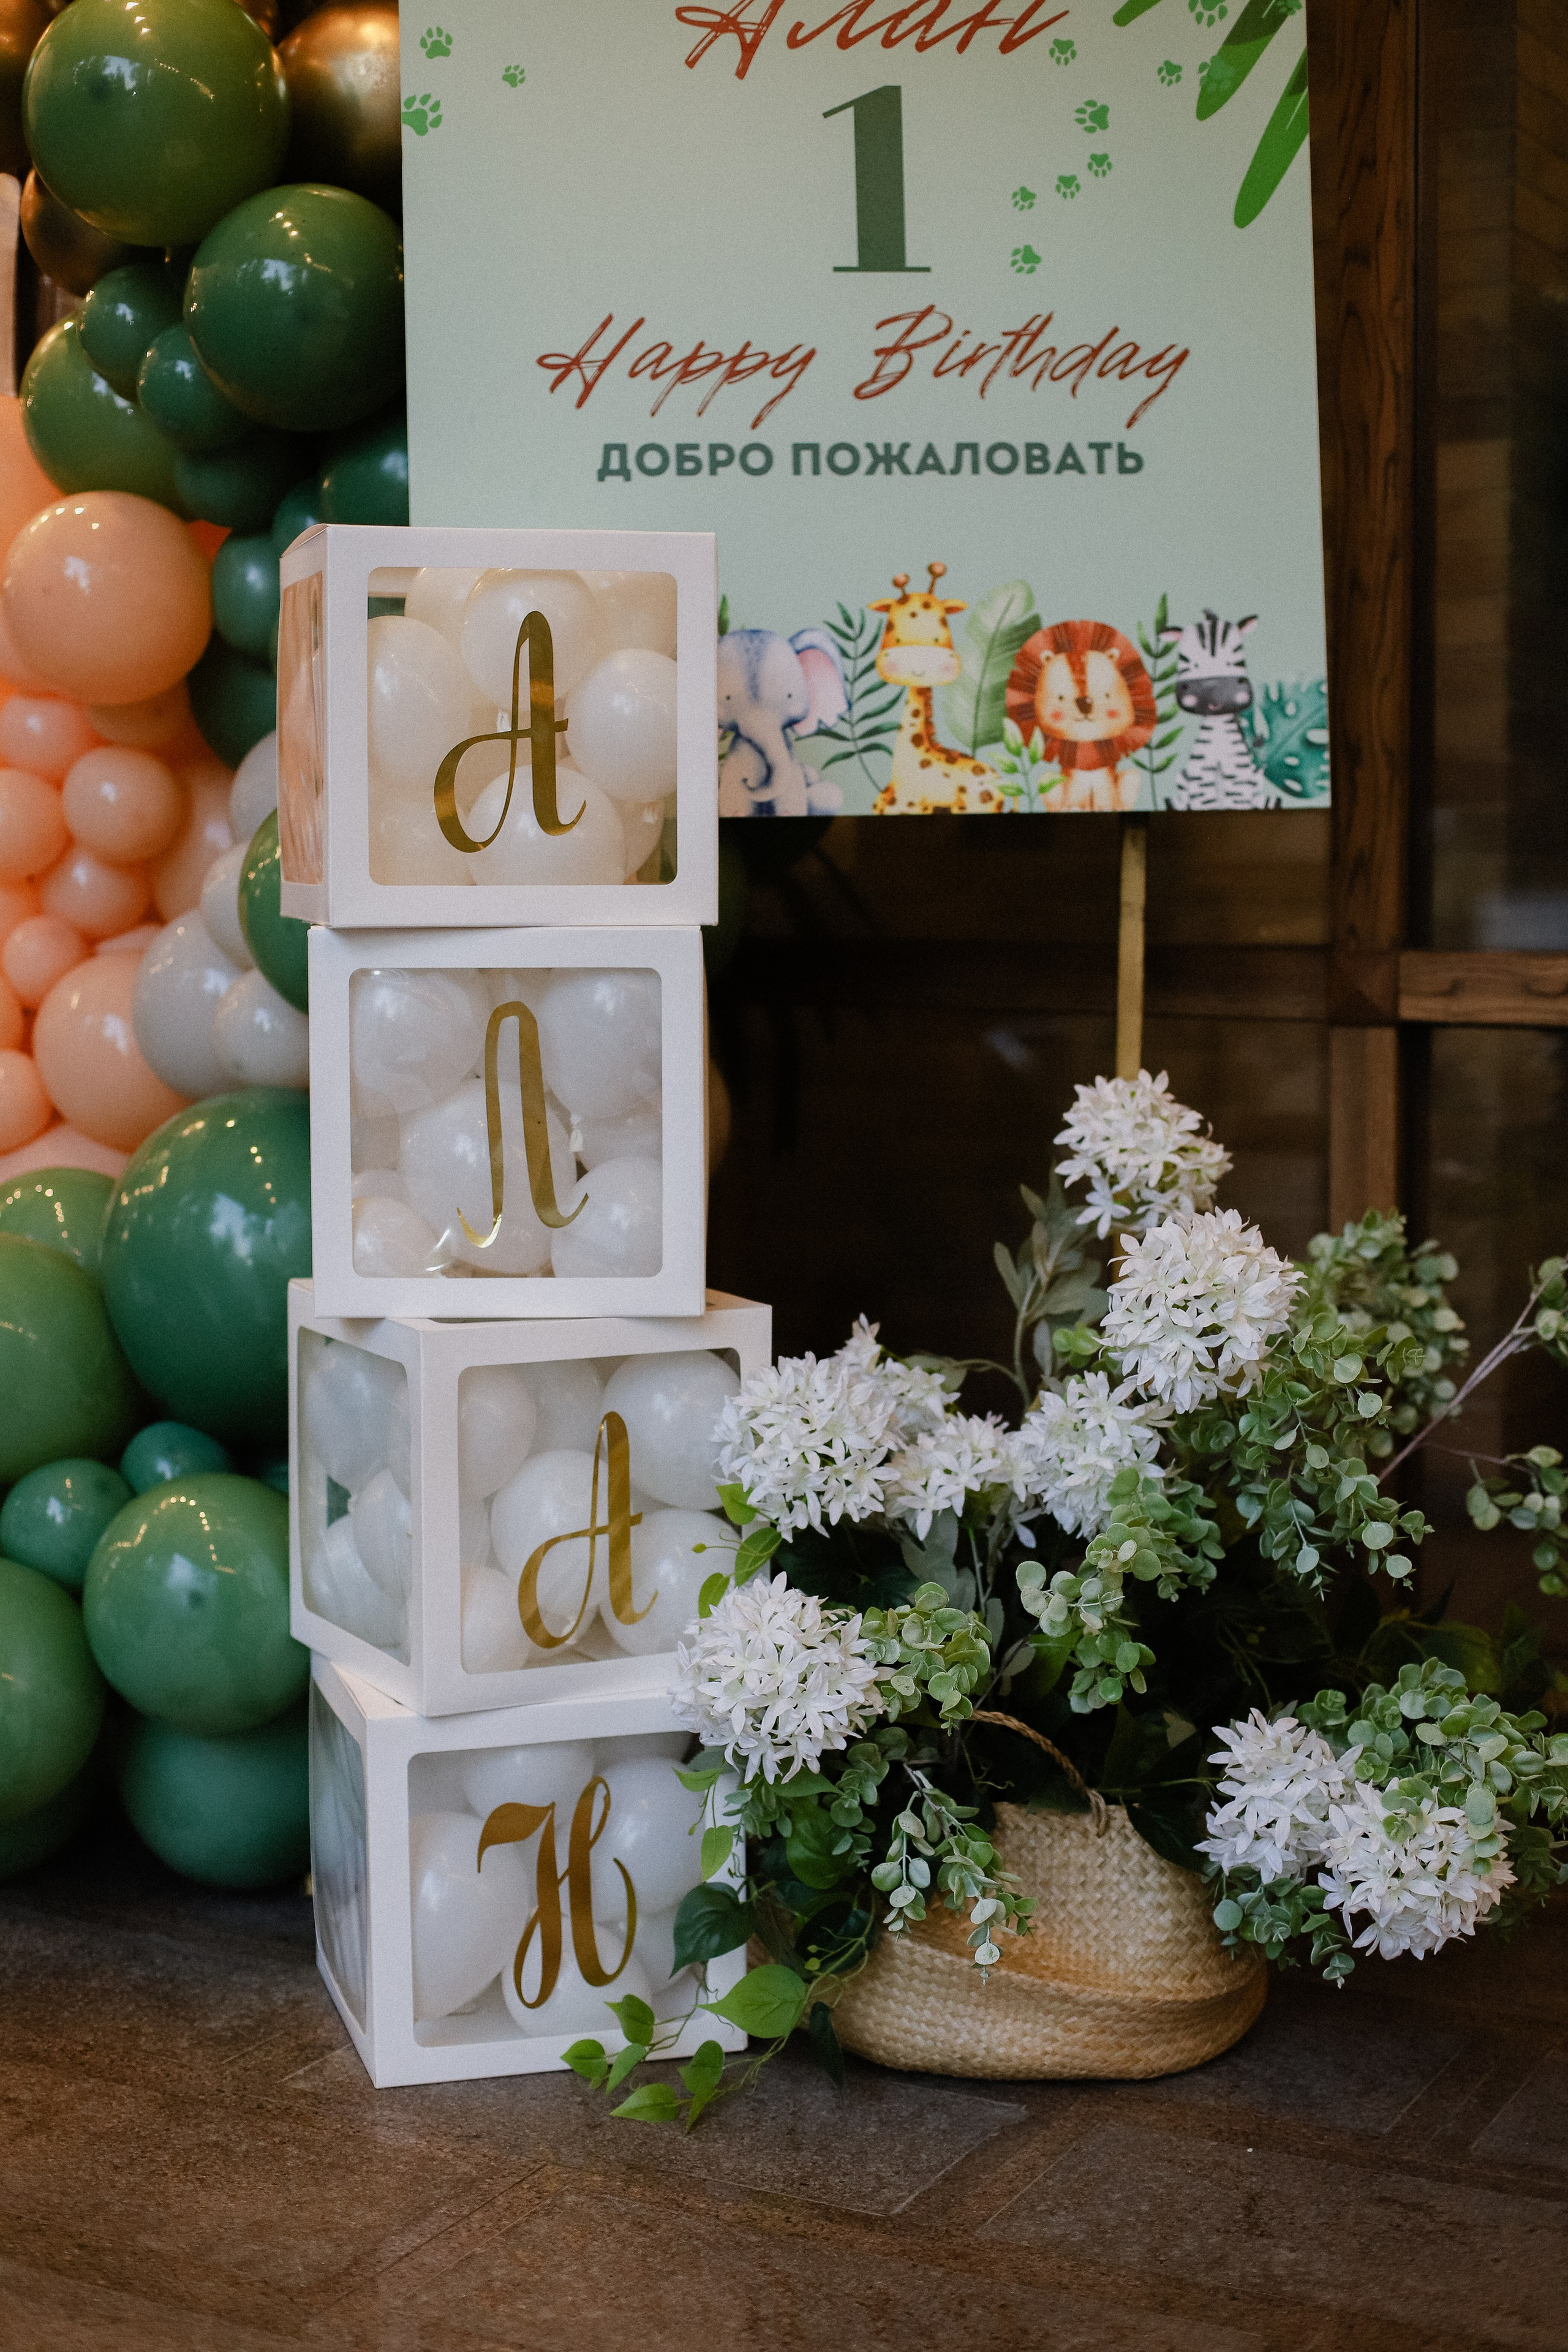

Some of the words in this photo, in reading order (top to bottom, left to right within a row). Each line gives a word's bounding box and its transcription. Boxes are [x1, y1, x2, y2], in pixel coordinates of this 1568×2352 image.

[823, 85, 932, 273] 1
[536, 312, 816, 430] Happy
[853, 304, 1191, 430] Birthday
[597, 442, 774, 483] ДОБРО
[791, 441, 1145, 477] ПОЖАЛОВАТЬ
[456, 1000, 589, 1248] Л
